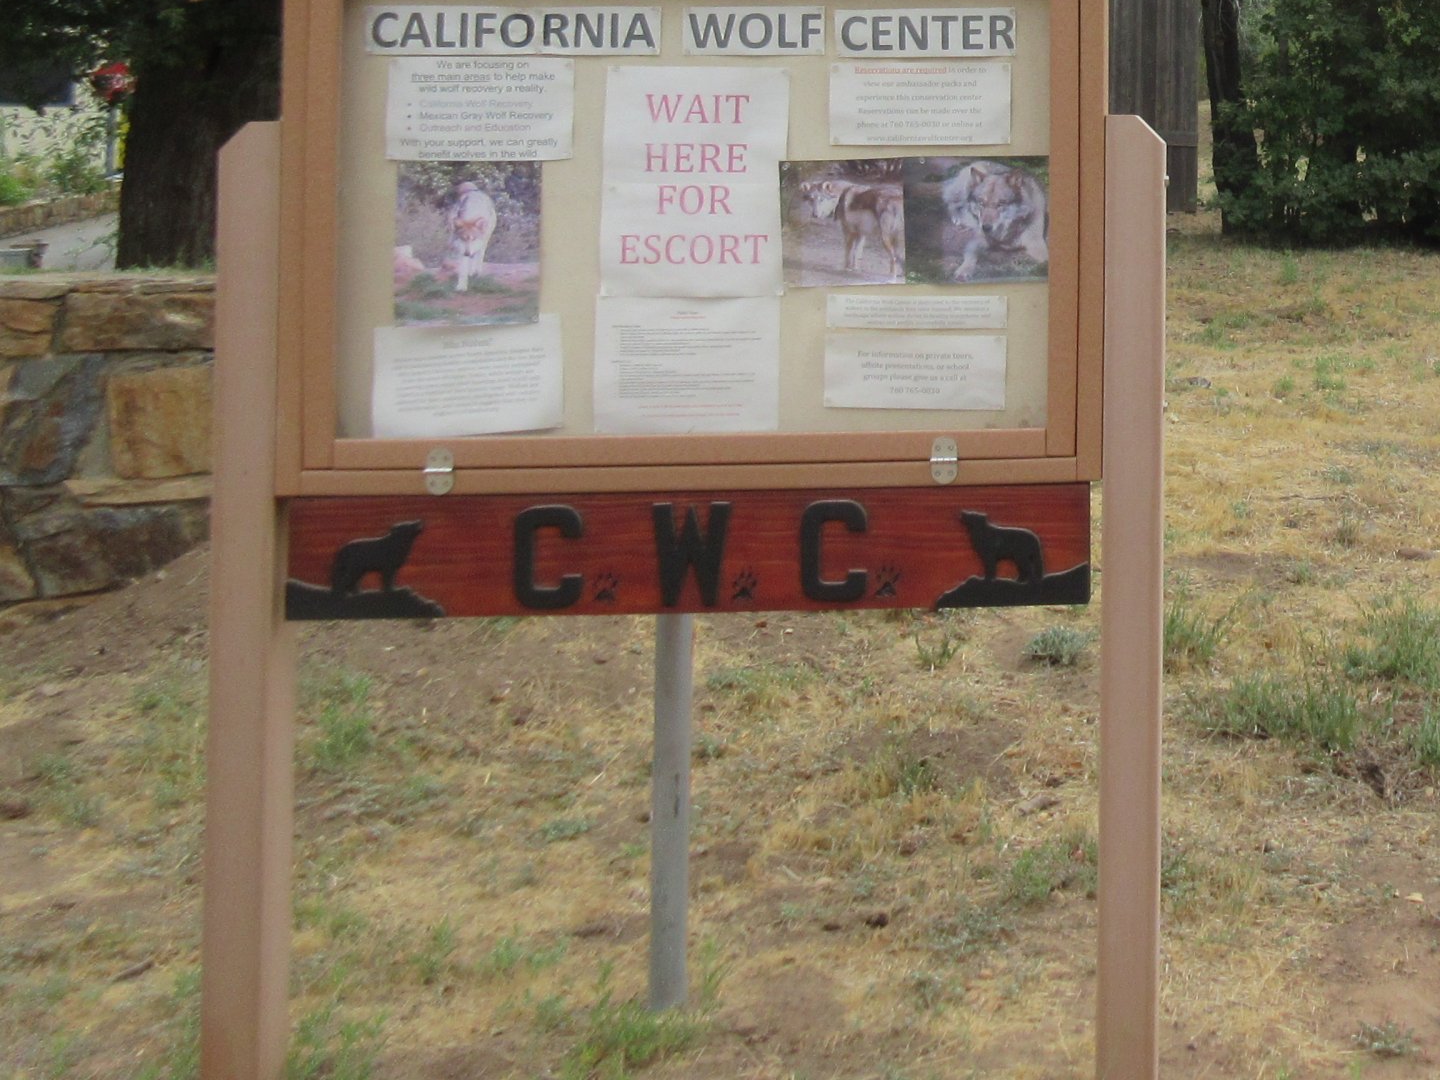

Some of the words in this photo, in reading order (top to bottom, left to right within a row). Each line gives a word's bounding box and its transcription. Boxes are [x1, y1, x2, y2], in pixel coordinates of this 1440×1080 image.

[371, 11, 656, 49] CALIFORNIA
[689, 12, 823, 50] WOLF
[840, 14, 1016, 51] CENTER
[411, 72, 435, 81] three
[437, 72, 461, 81] main
[505, 72, 526, 83] help
[529, 72, 555, 81] make
[456, 61, 471, 69] are
[473, 60, 514, 71] focusing
[645, 93, 751, 124] WAIT
[645, 142, 748, 174] HERE
[656, 184, 733, 216] FOR
[619, 233, 769, 265] ESCORT
